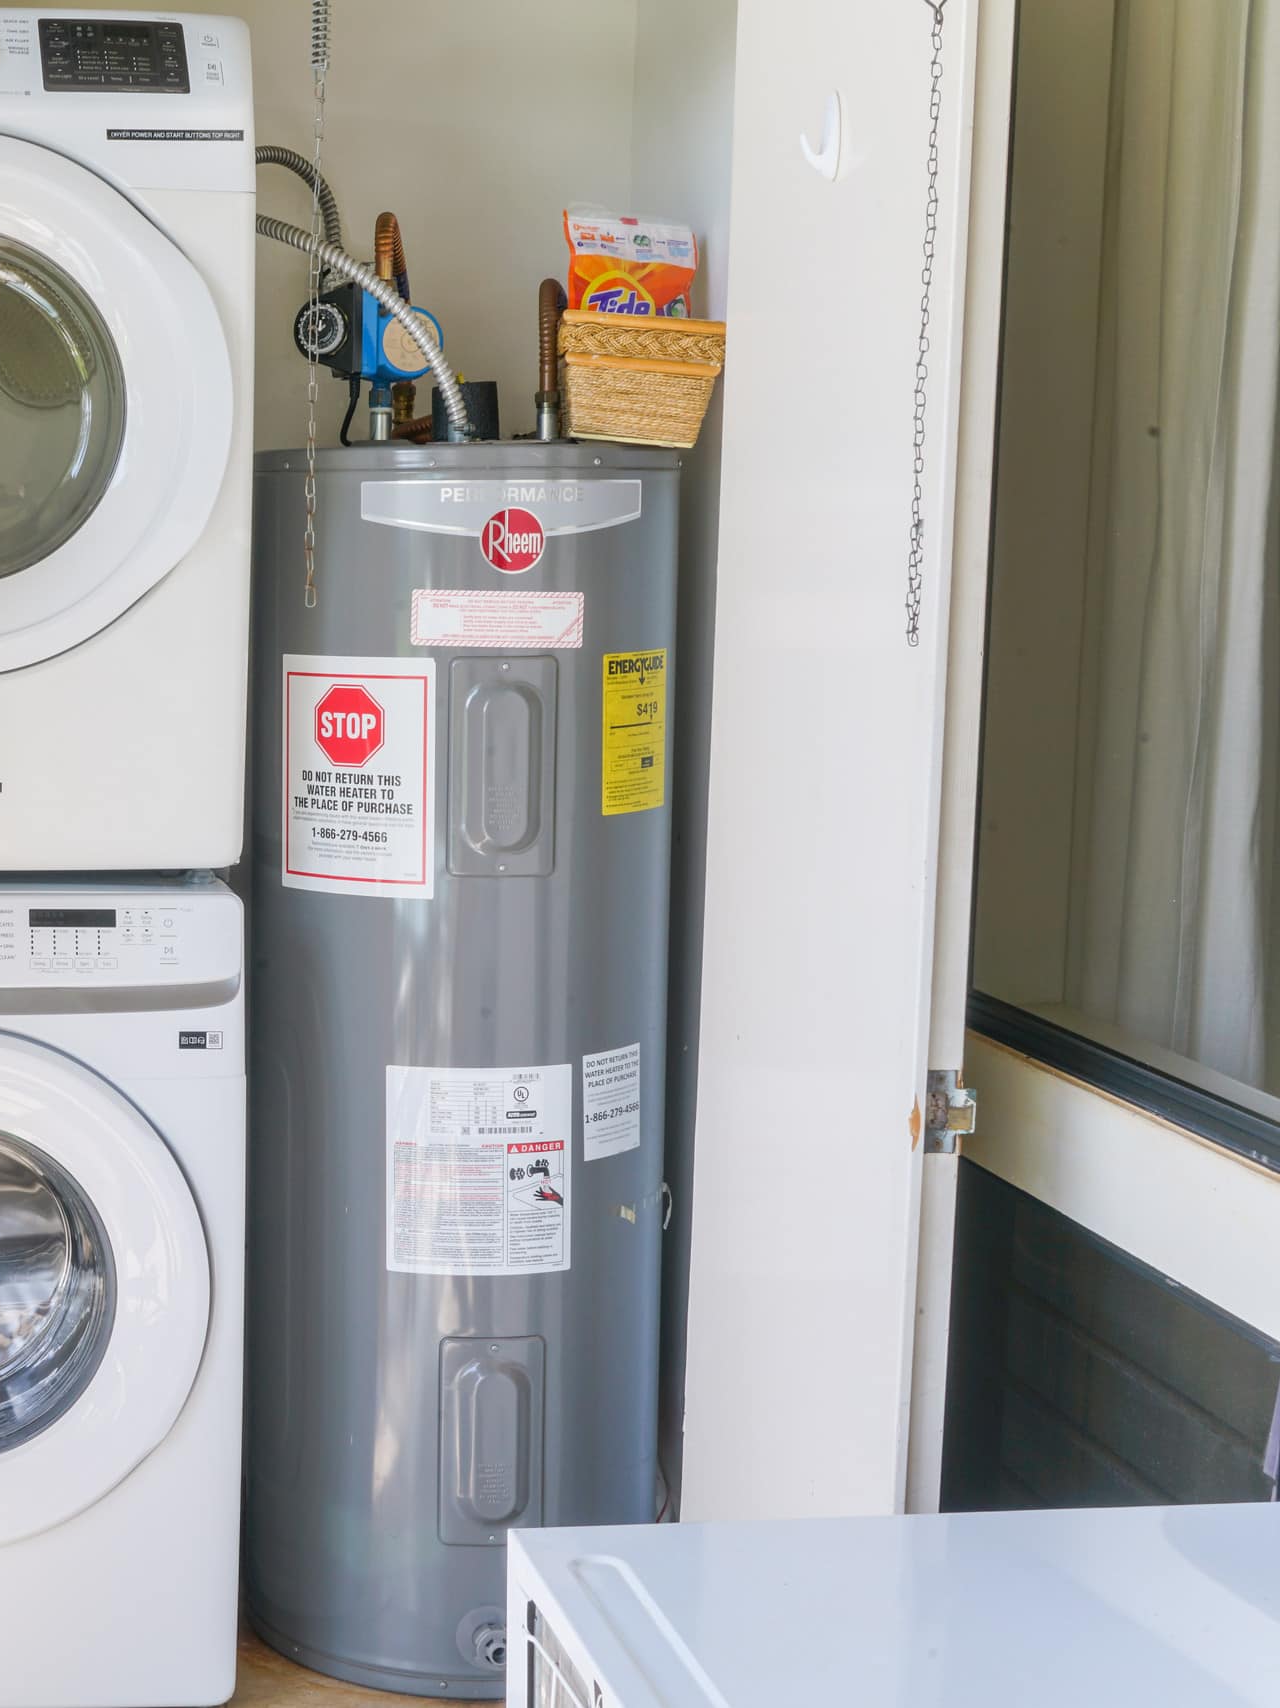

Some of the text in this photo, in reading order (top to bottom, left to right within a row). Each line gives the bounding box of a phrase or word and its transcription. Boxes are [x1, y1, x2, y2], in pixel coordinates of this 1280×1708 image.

[440, 488, 584, 502] PERMANCE
[488, 510, 541, 562] Rheem
[320, 712, 376, 739] STOP
[302, 770, 401, 786] DO NOT RETURN THIS
[307, 784, 394, 800] WATER HEATER TO
[294, 796, 413, 815] THE PLACE OF PURCHASE
[312, 827, 388, 843] 1-866-279-4566
[586, 1050, 638, 1068] DO NOT RETURN THIS
[585, 1070, 604, 1078] WATER
[606, 1064, 624, 1074] HEATER
[624, 1061, 631, 1070] TO
[588, 1070, 637, 1088] PLACE OF PURCHASE
[585, 1101, 639, 1124] 1-866-279-4566
[521, 1142, 560, 1152] DANGER
